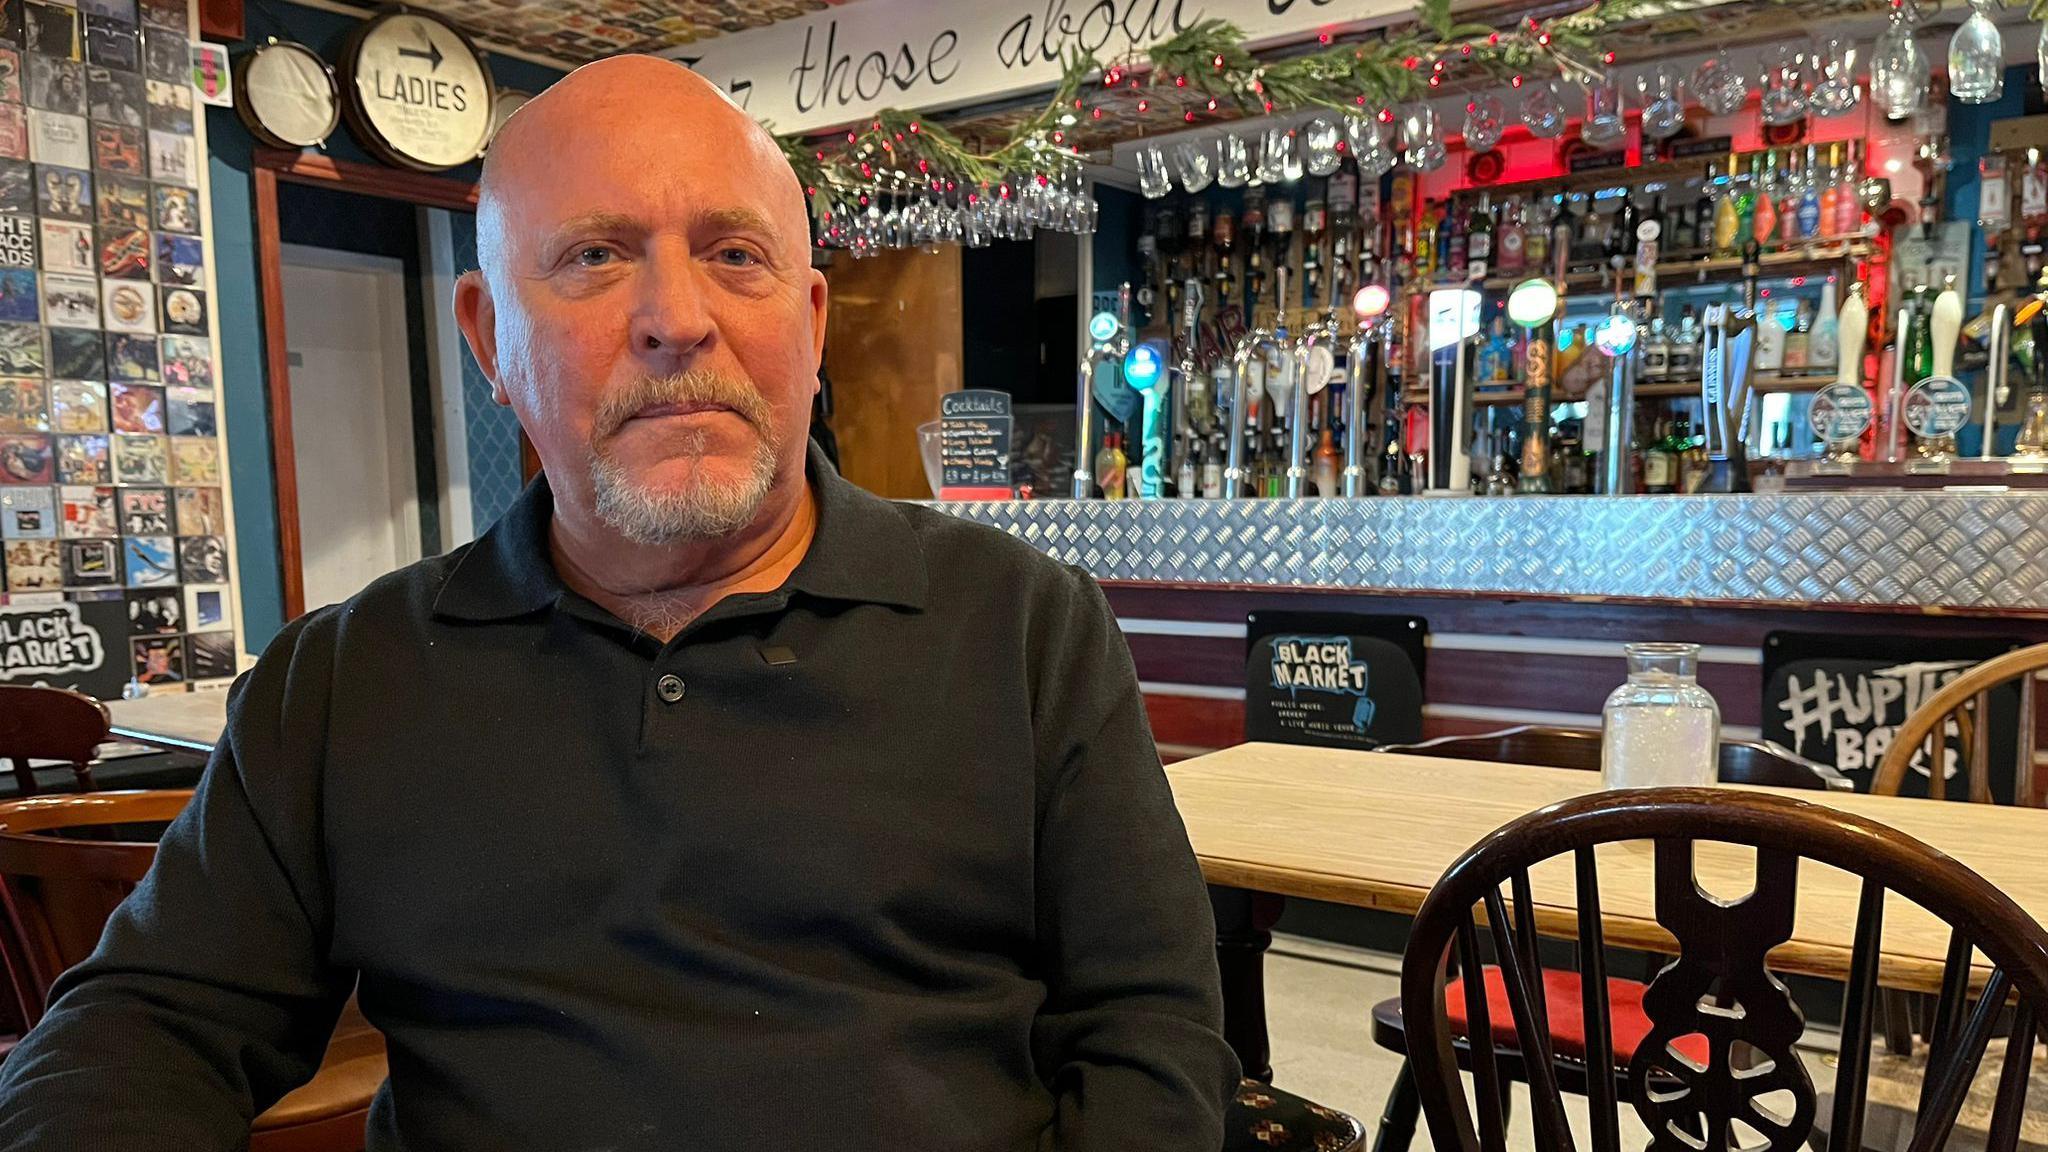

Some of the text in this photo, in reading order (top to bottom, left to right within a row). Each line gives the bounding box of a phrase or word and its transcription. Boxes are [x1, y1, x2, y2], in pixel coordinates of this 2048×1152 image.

[789, 21, 960, 113] those
[375, 70, 467, 112] LADIES
[942, 397, 1004, 415] Cocktails
[0, 614, 71, 645] LACK
[1277, 642, 1350, 667] BLACK
[1272, 661, 1367, 689] MARKET
[1288, 720, 1305, 729] LIVE
